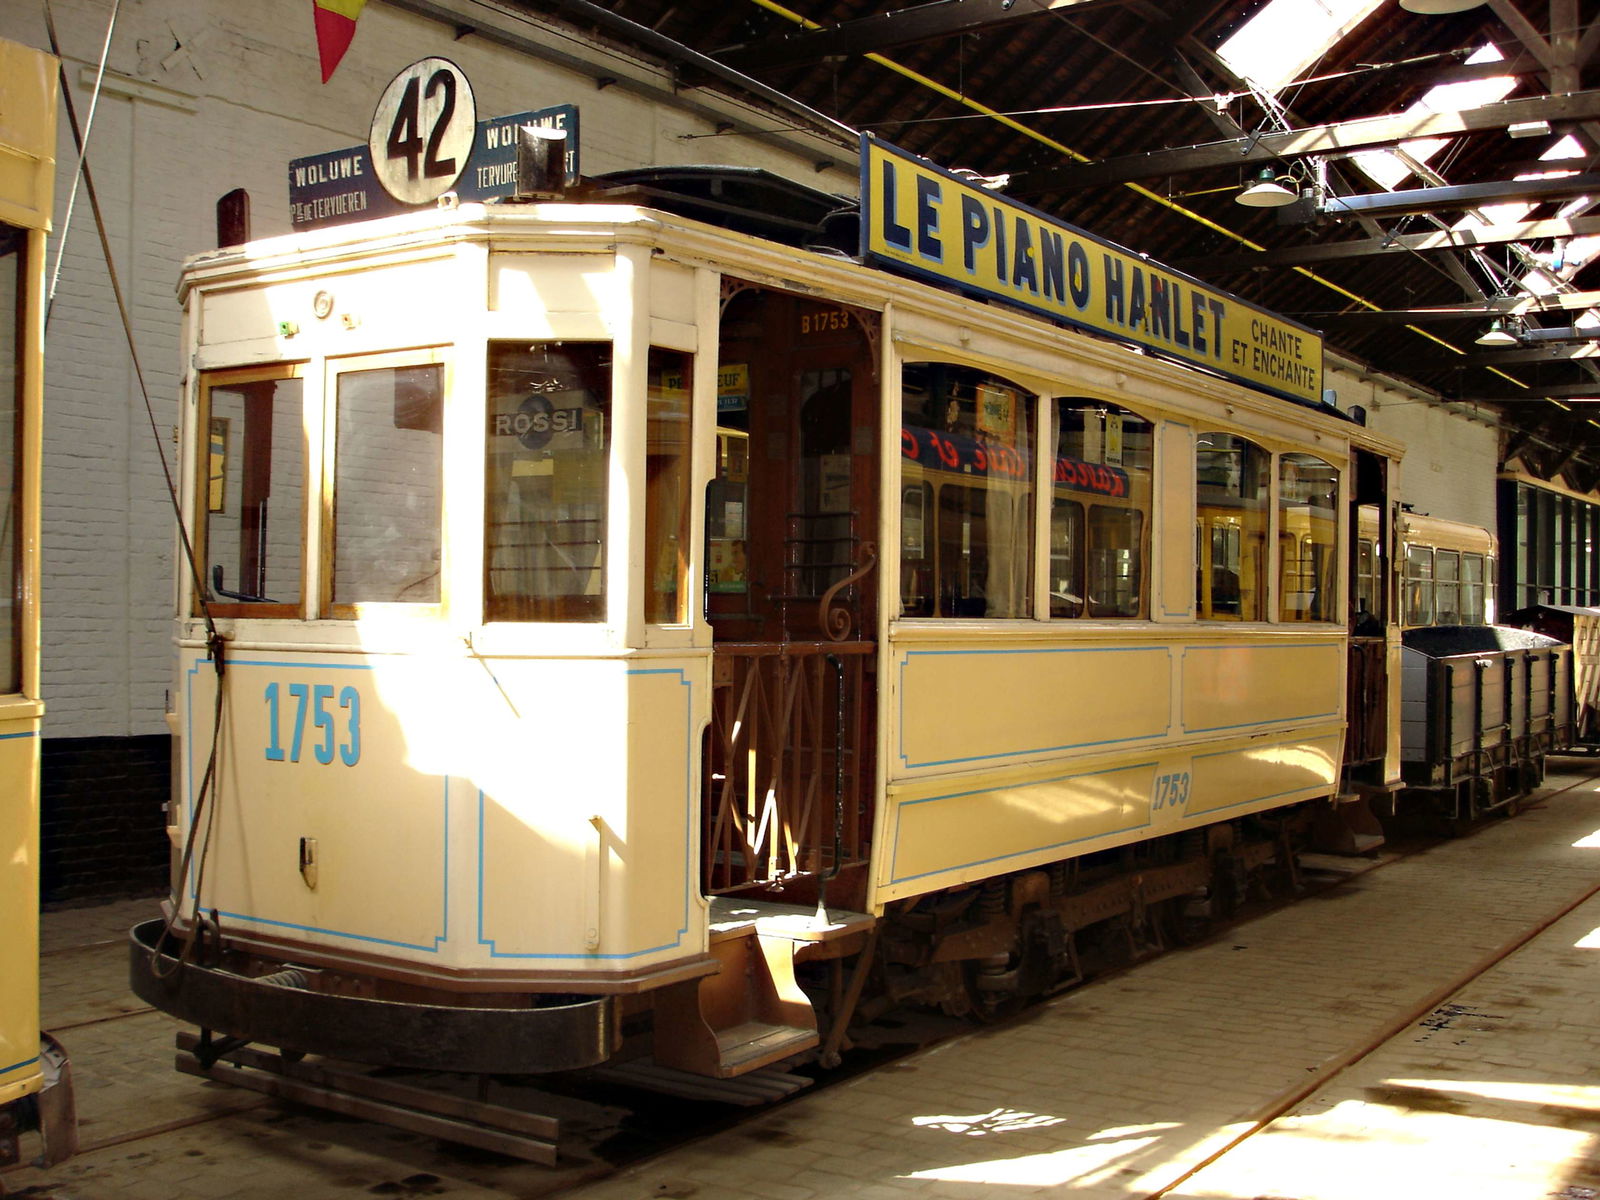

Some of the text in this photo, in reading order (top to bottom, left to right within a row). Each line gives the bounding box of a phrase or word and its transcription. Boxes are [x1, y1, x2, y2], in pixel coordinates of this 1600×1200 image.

[386, 69, 456, 182] 42
[294, 155, 363, 187] WOLUWE
[477, 161, 518, 190] TERVURE
[312, 191, 367, 219] TERVUEREN
[882, 159, 1225, 361] LE PIANO HANLET
[802, 311, 849, 334] B 1753
[1251, 318, 1303, 360] CHANTE
[718, 372, 740, 388] EUF
[1232, 338, 1316, 391] ET ENCHANTE
[495, 408, 578, 437] ROSSI
[264, 682, 361, 767] 1753
[1152, 772, 1190, 811] 1753
